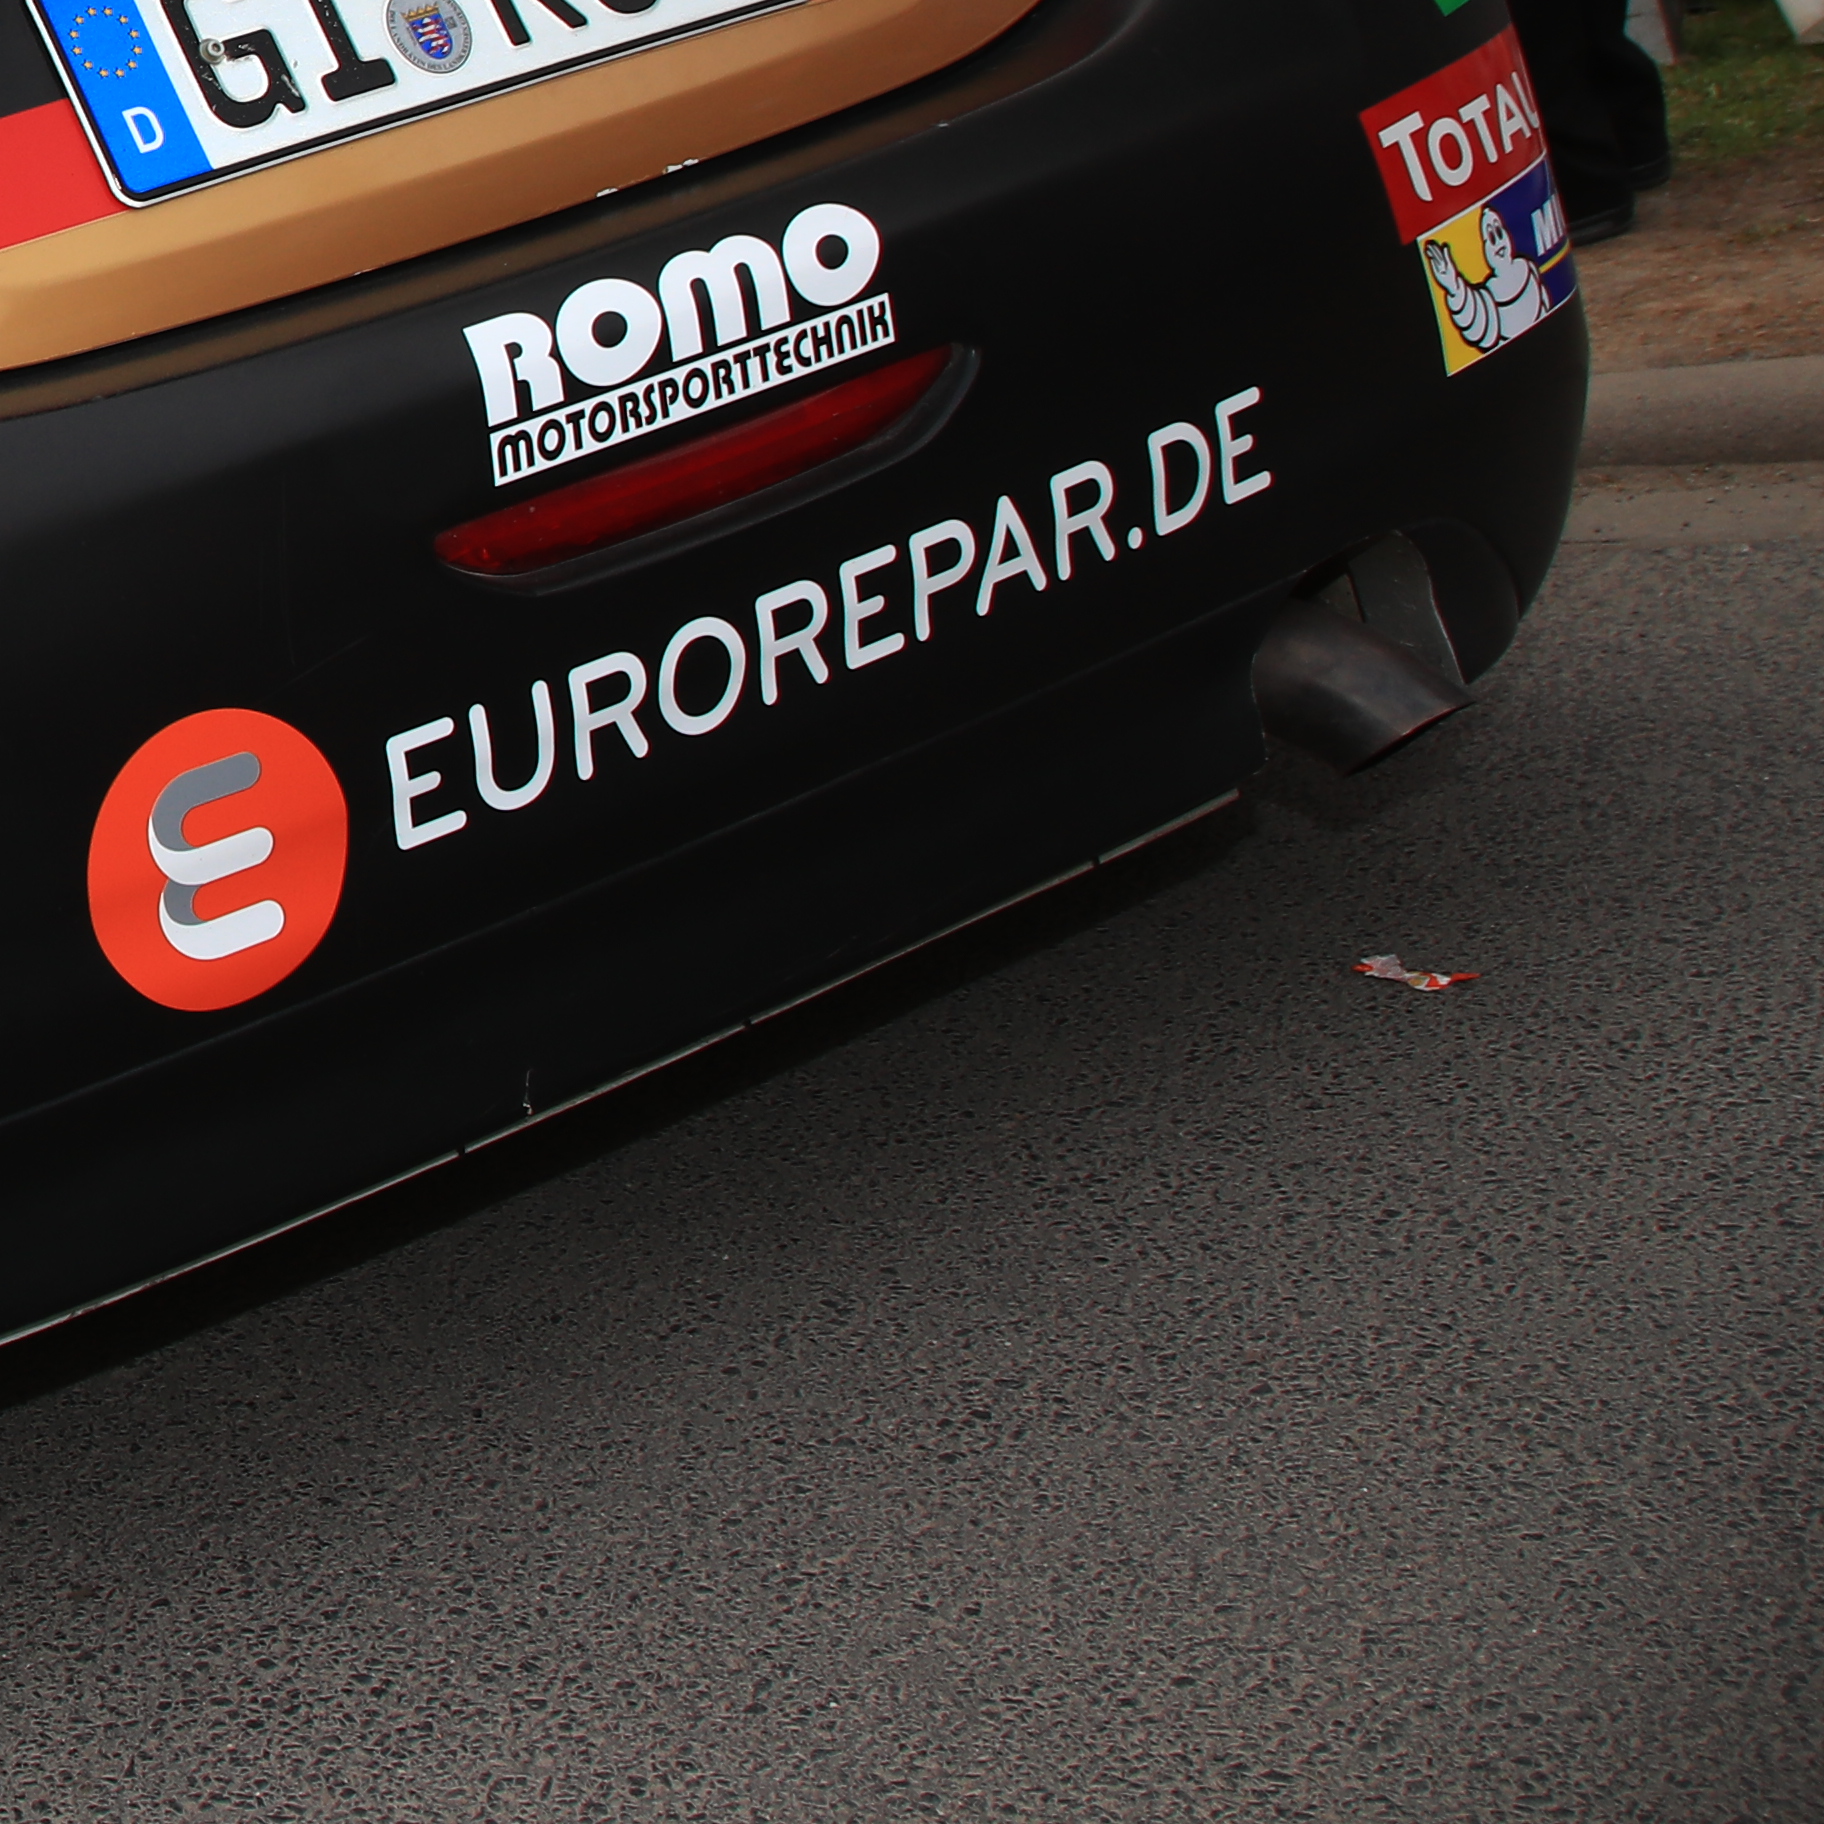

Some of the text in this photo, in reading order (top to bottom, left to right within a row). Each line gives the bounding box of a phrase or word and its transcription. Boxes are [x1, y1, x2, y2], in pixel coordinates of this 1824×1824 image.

[122, 105, 165, 155] D
[462, 203, 880, 426] ROMO
[495, 300, 892, 477] MOTORSPORTTECHNIK
[386, 387, 1273, 850] EUROREPAR.DE
